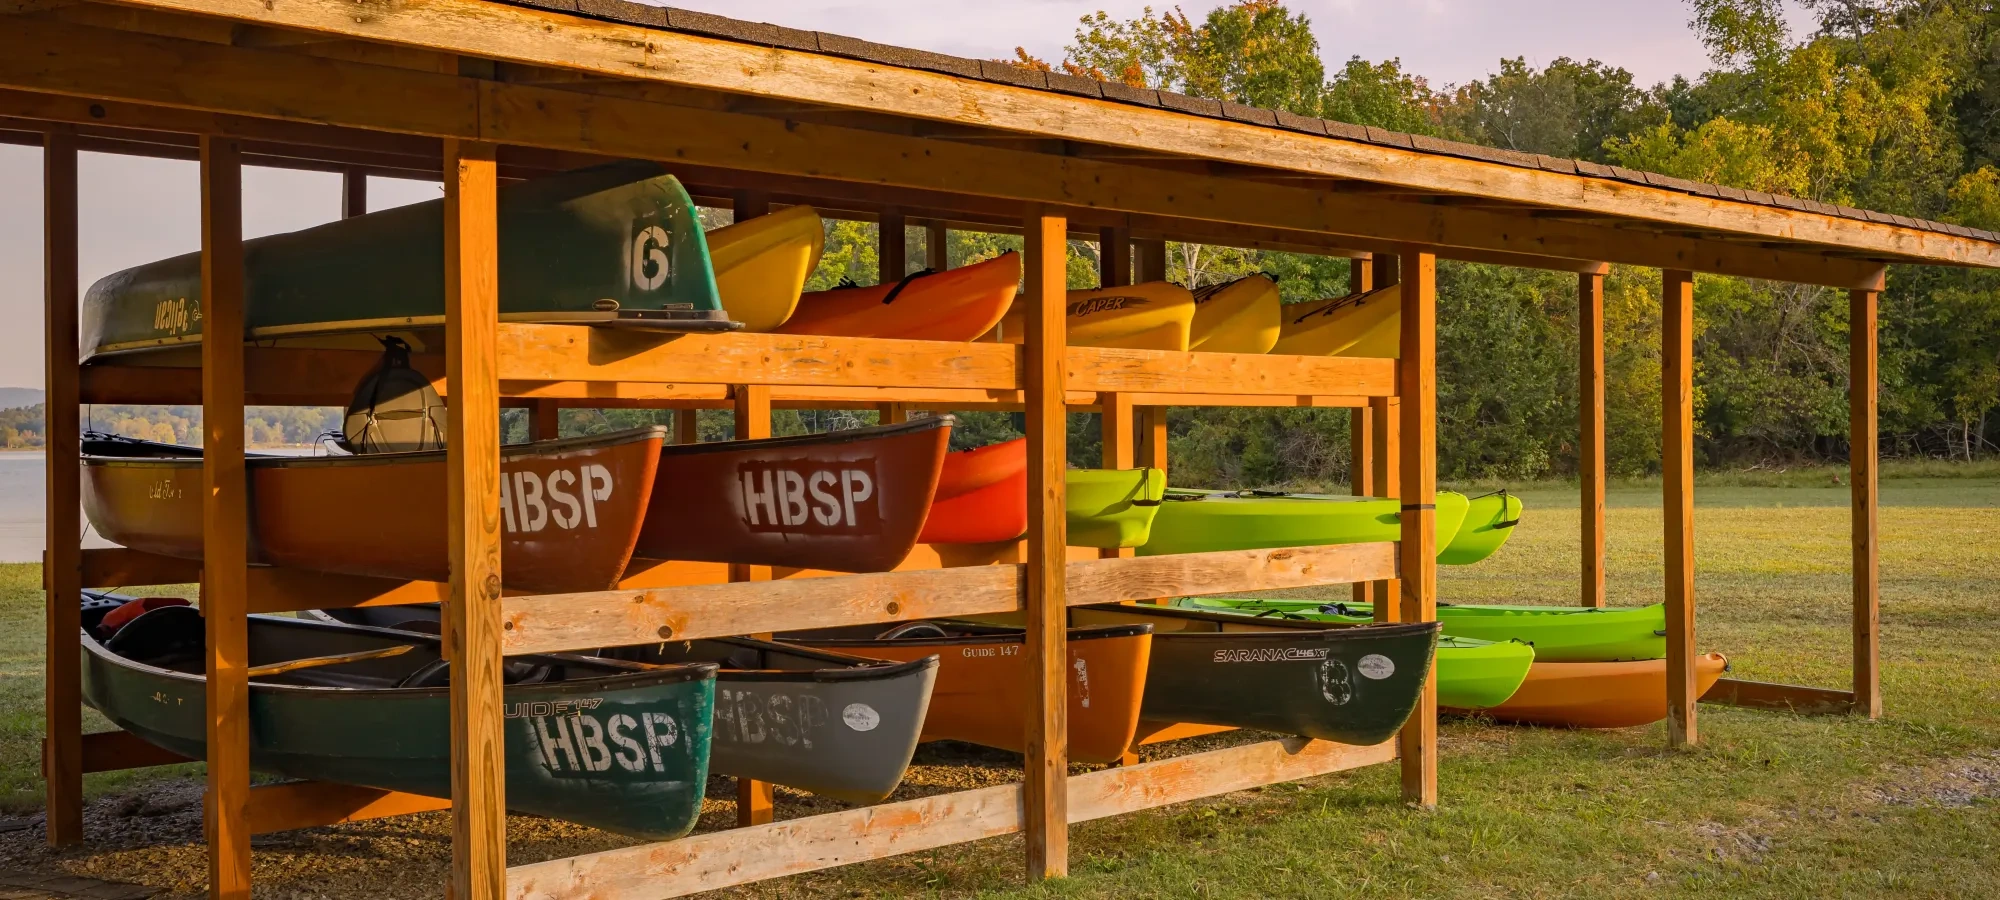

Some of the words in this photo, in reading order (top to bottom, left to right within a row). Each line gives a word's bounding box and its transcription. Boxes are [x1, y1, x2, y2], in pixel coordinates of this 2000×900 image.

[633, 225, 669, 291] 6
[1075, 297, 1125, 317] CAPER
[744, 470, 873, 527] HBSP
[963, 647, 996, 658] GUIDE
[1000, 645, 1019, 656] 147
[1213, 648, 1297, 663] SARANAC
[1320, 658, 1352, 706] 8
[503, 701, 572, 719] UIDE
[573, 698, 604, 710] 147
[537, 712, 678, 772] HBSP
